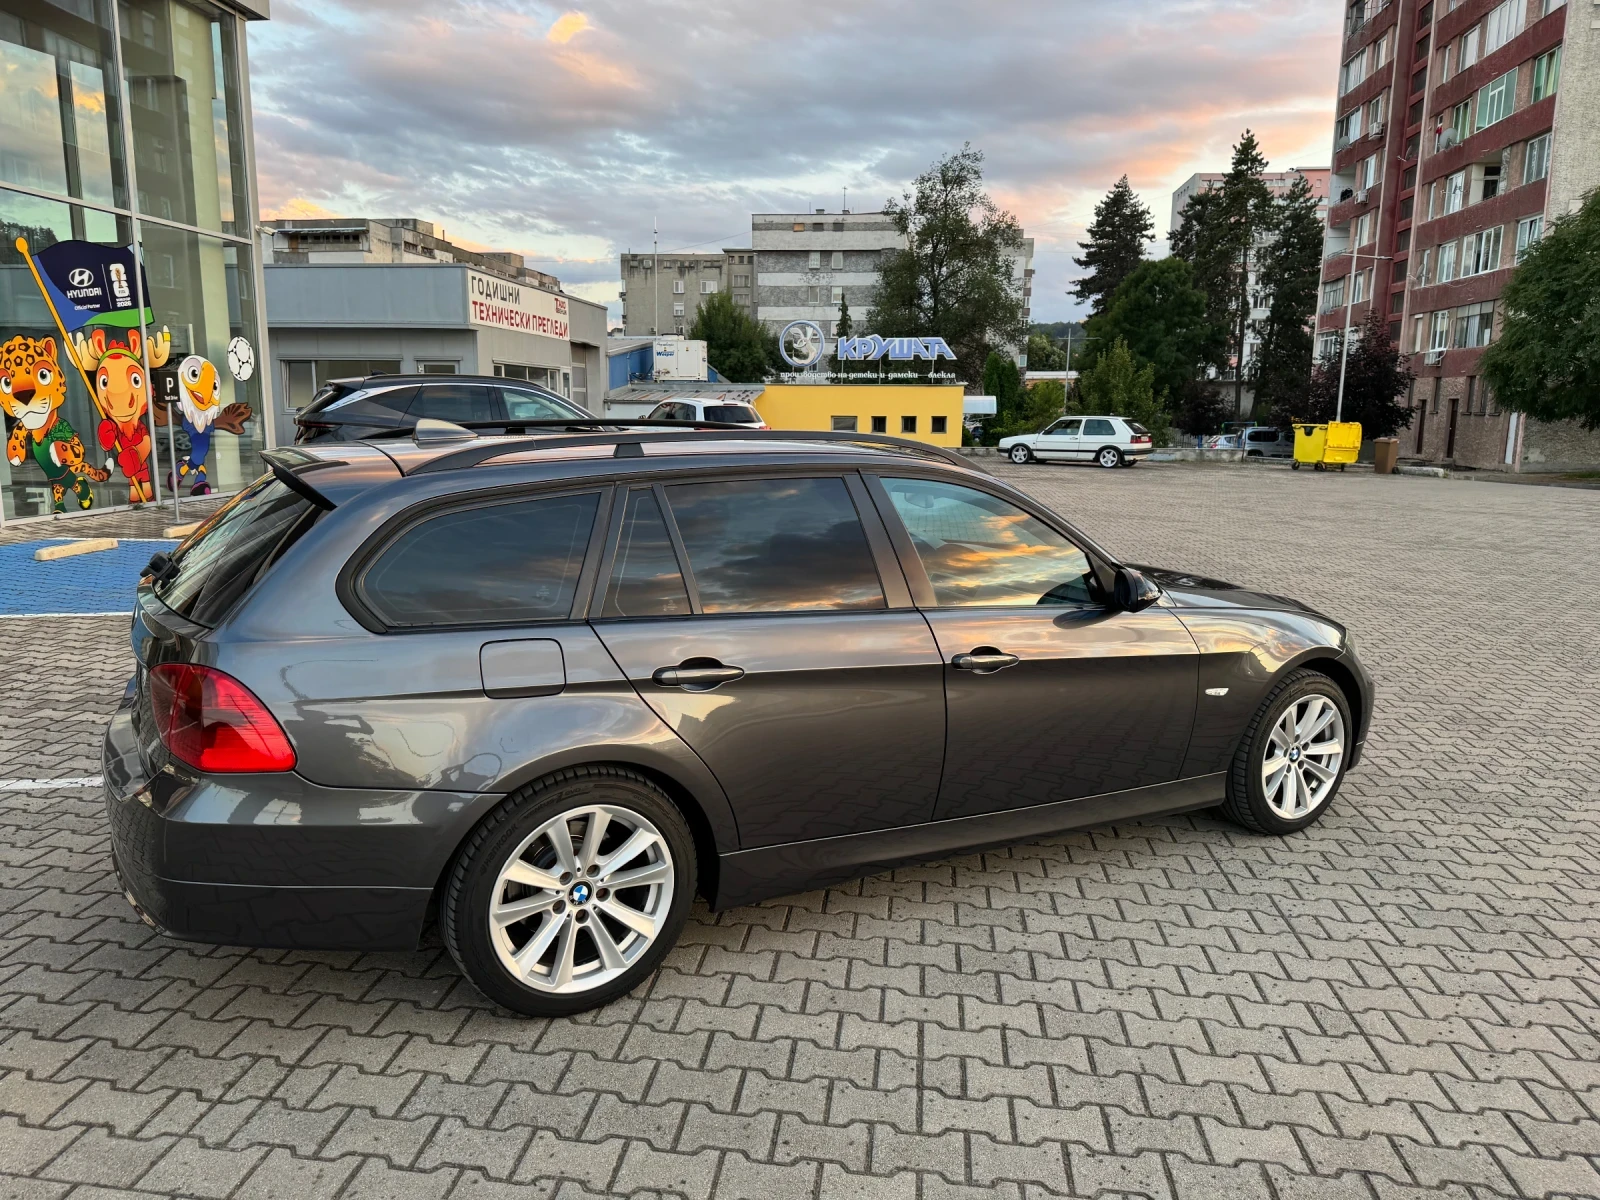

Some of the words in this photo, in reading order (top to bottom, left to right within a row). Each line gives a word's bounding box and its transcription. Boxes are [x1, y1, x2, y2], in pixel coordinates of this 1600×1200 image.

[67, 287, 102, 298] HYUNDAI
[471, 275, 520, 305] ГОДИШНИ
[472, 300, 531, 330] ТЕХНИЧЕСКИ
[532, 314, 568, 339] ПРЕГЛЕДИ
[837, 334, 957, 361] КРУШАТА
[166, 378, 174, 393] P
